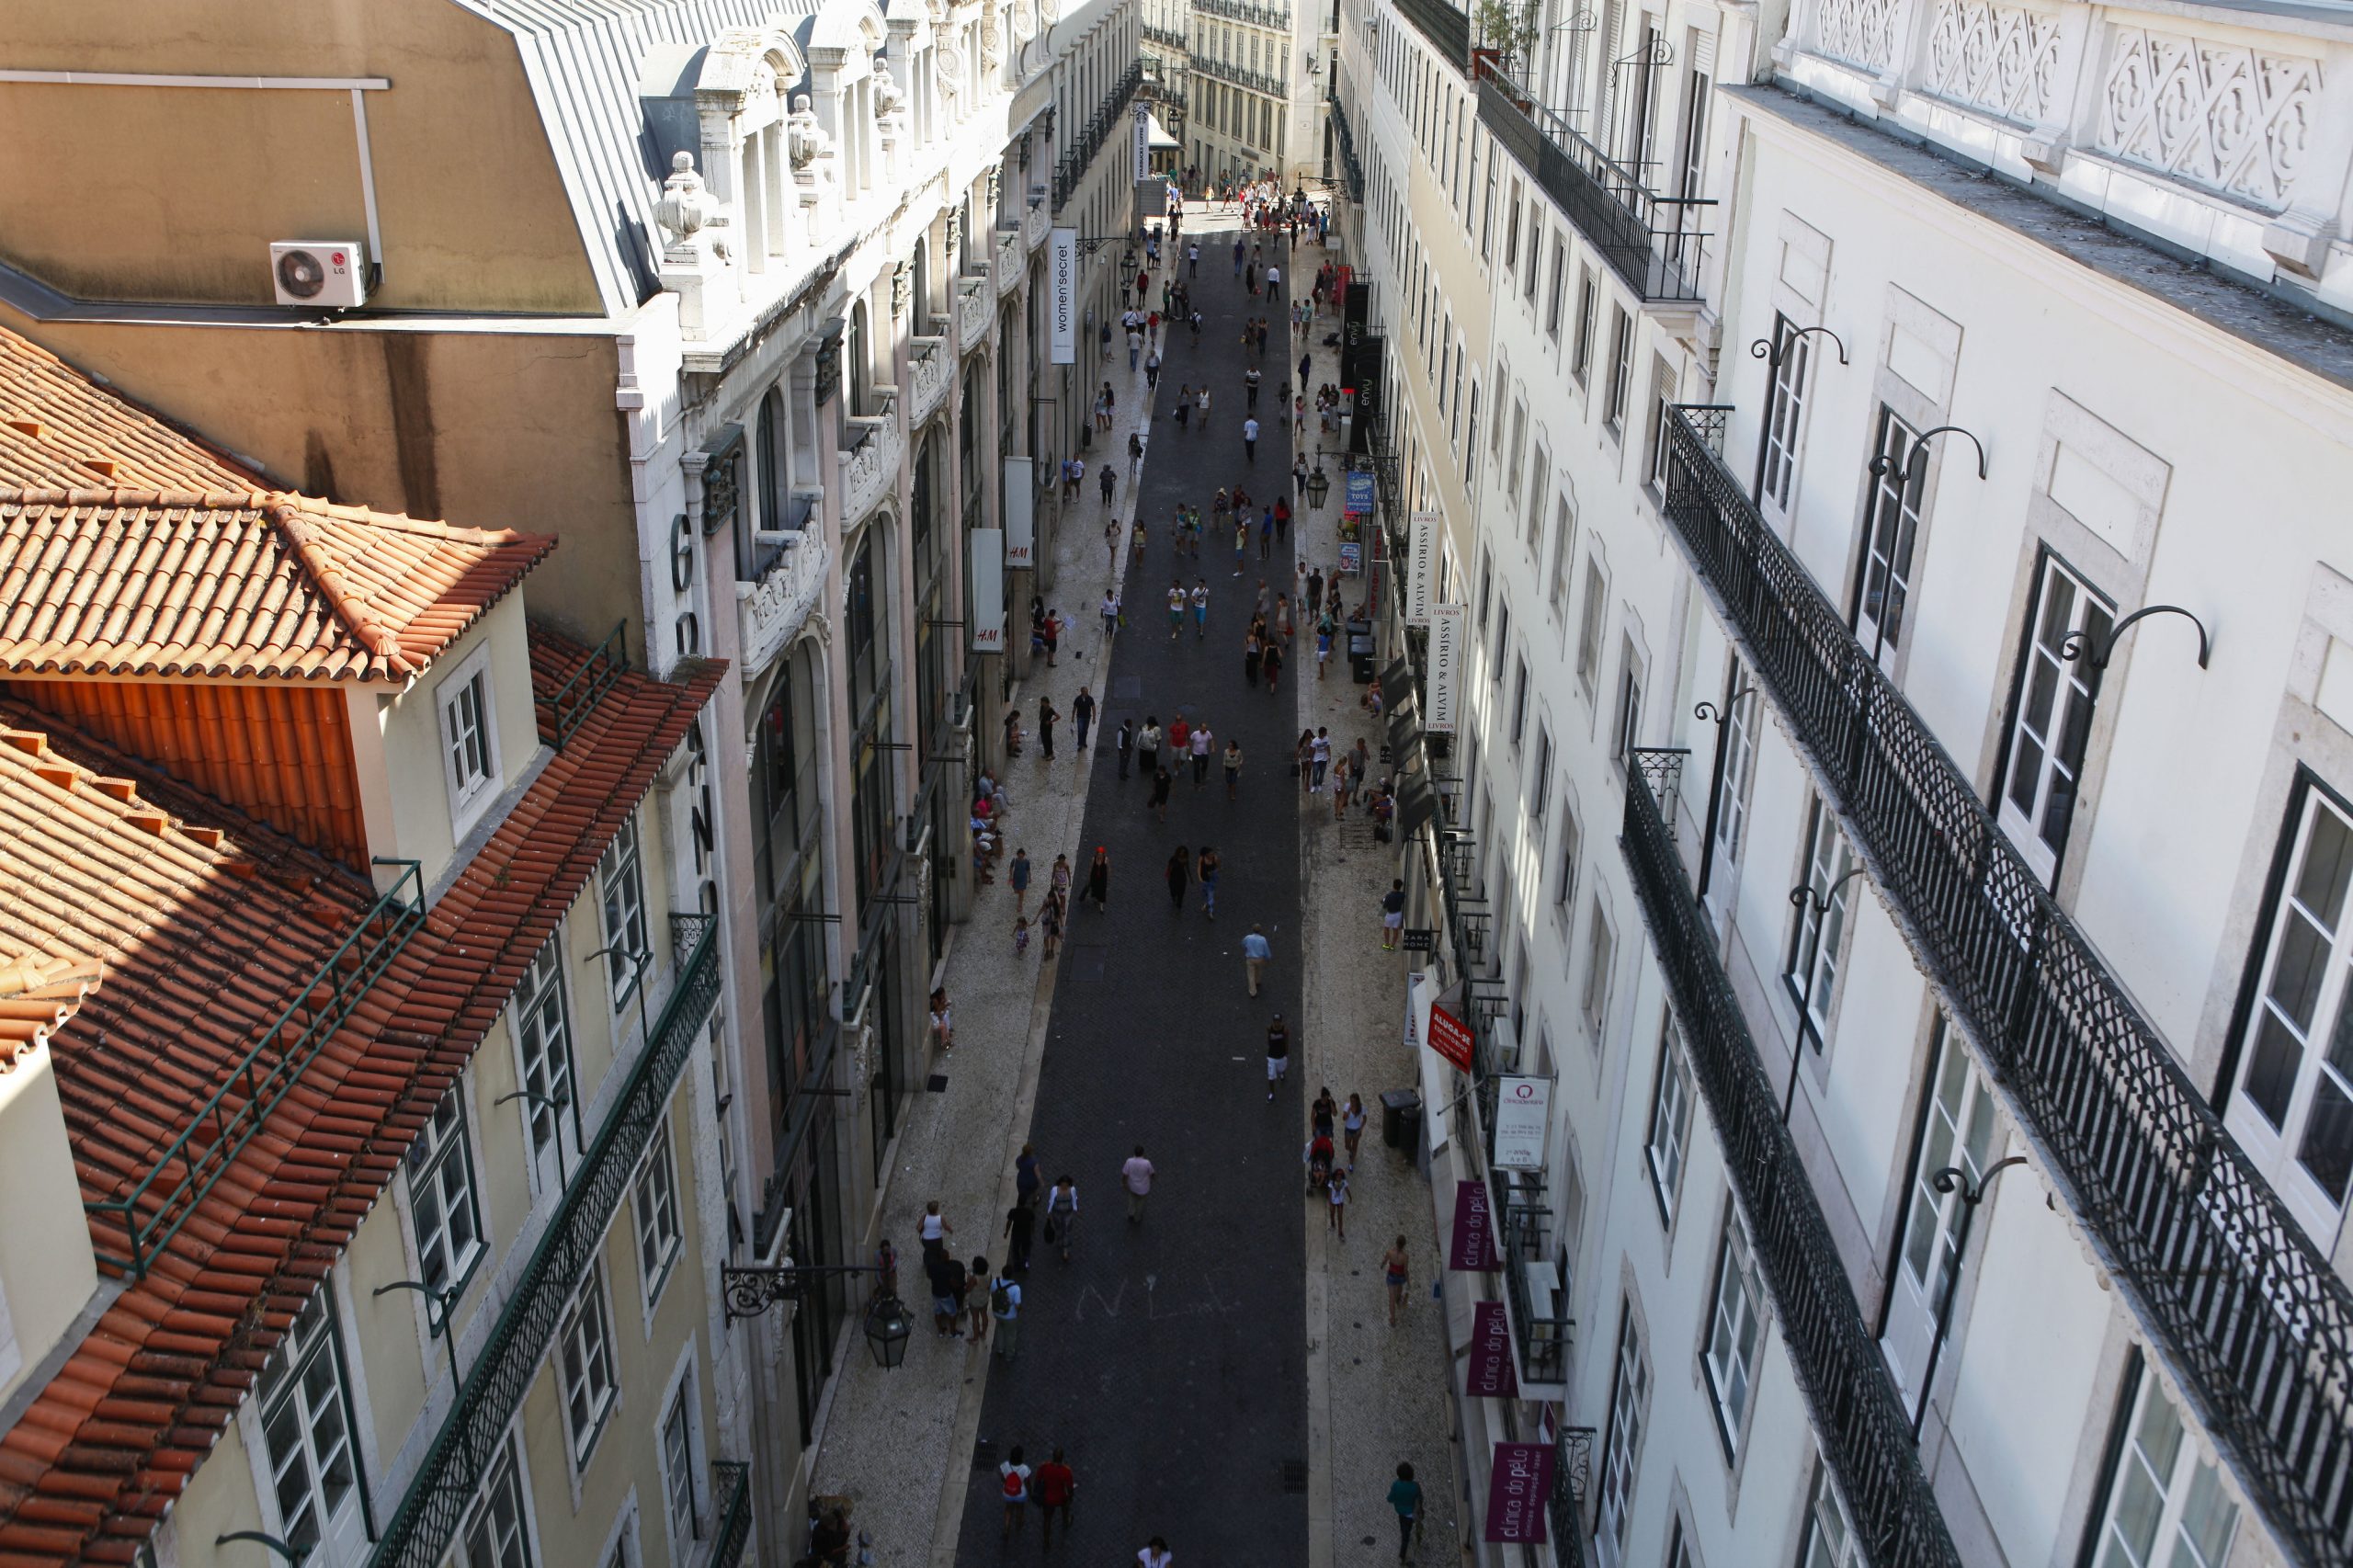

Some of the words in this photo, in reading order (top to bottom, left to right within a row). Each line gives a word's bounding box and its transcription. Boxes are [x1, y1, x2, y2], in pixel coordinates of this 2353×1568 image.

[1057, 244, 1067, 333] women'secret
[1349, 321, 1360, 346] envy
[1361, 378, 1372, 406] envy
[1417, 525, 1428, 569] ASSÍRIO
[1417, 572, 1425, 580] &
[1415, 583, 1425, 617] ALVIM
[1438, 618, 1451, 667] ASSÍRIO
[1438, 671, 1447, 680] &
[1437, 684, 1447, 721] ALVIM
[1434, 1013, 1472, 1046] ALUGA-SE
[1465, 1215, 1483, 1228] do
[1483, 1338, 1502, 1351] do
[1504, 1480, 1524, 1495] do
